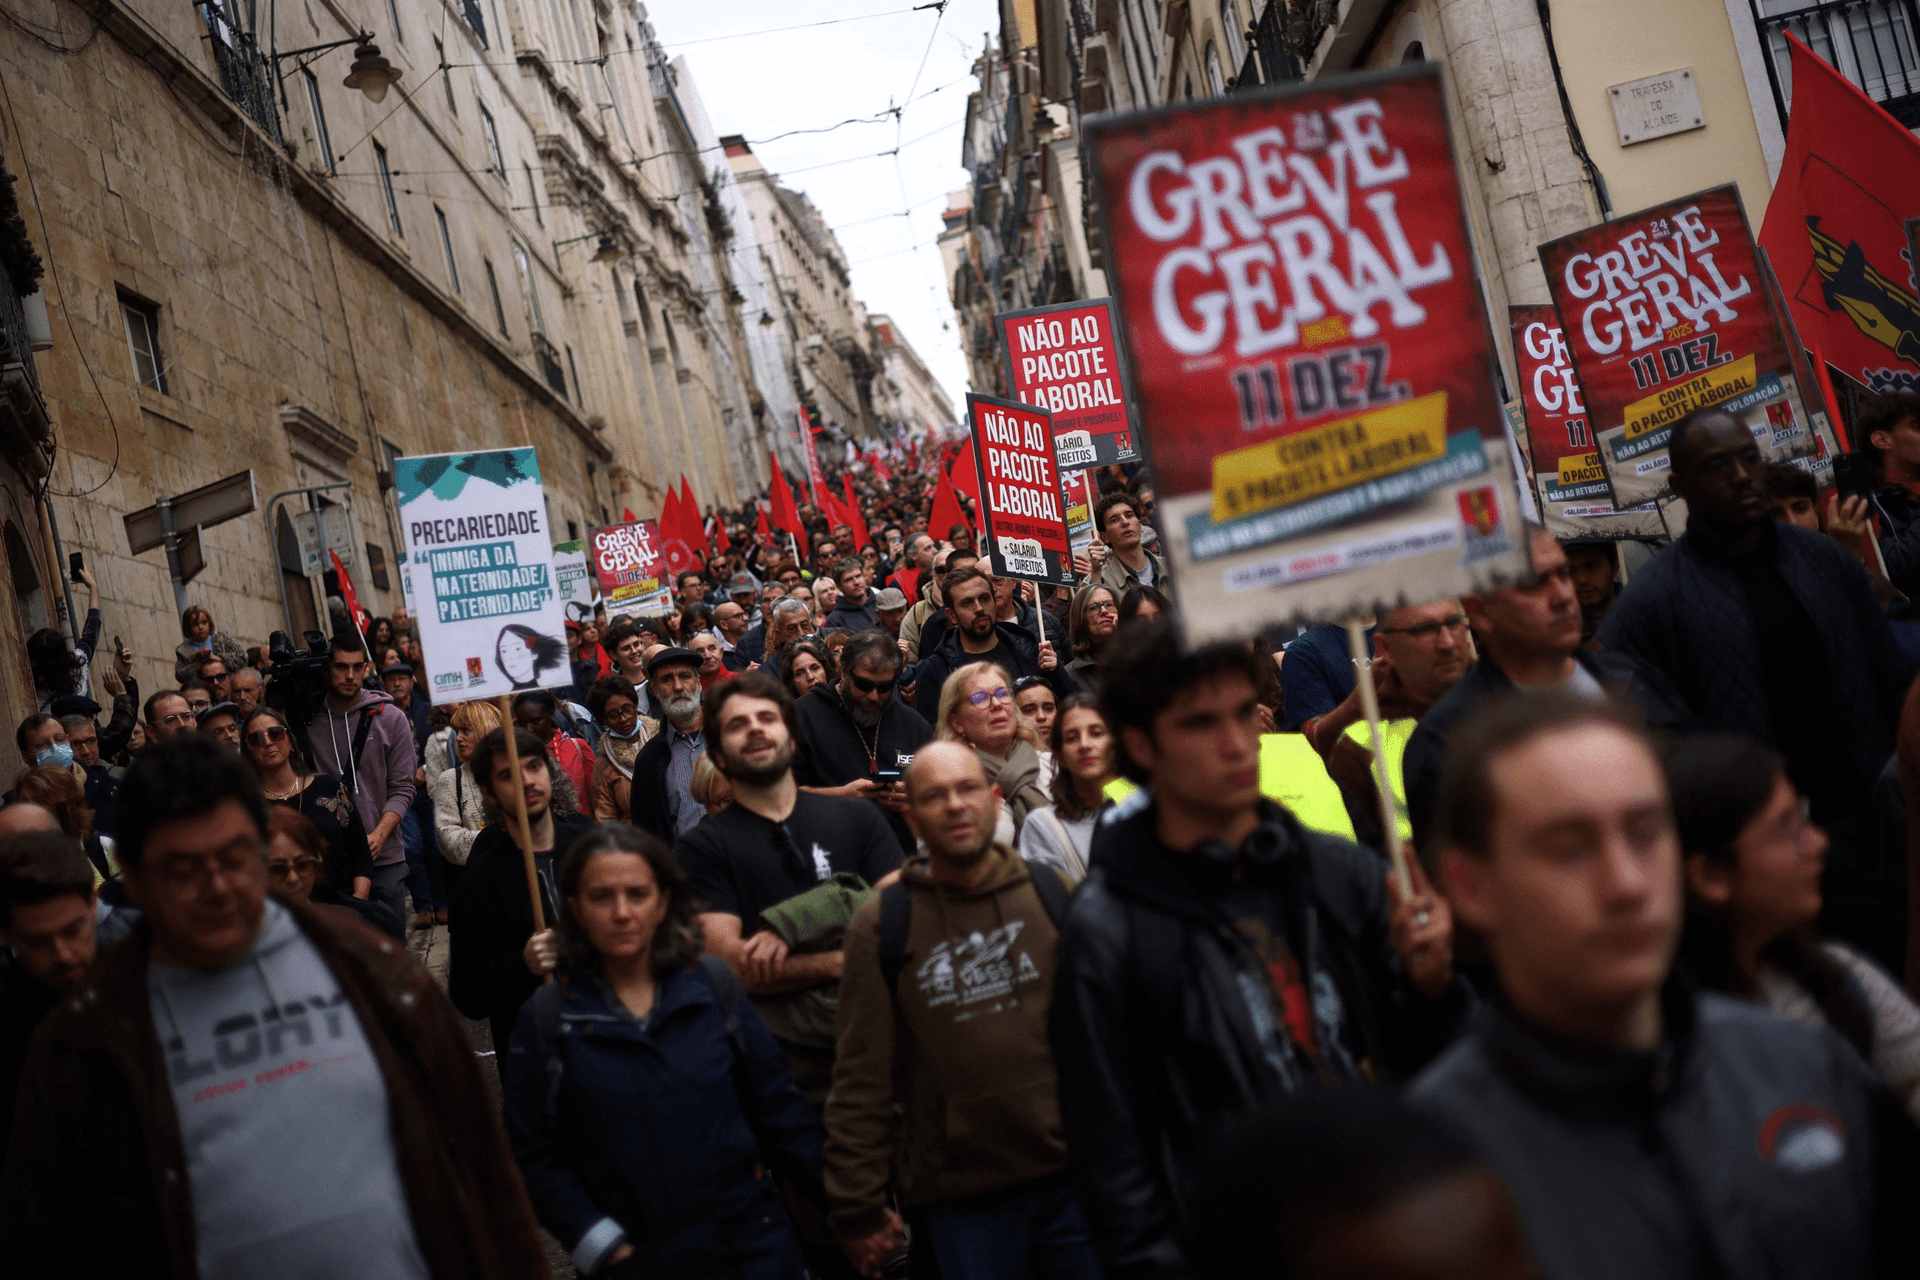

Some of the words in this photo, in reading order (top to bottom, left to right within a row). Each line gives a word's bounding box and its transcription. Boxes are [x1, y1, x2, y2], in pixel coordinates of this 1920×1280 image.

[1631, 80, 1674, 99] TRAVESSA
[1650, 100, 1663, 111] DO
[1643, 113, 1680, 130] ALCAIDE
[1129, 99, 1409, 252] GREVE
[1650, 218, 1669, 234] 24
[1565, 206, 1719, 300] GREVE
[1153, 192, 1453, 356] GERAL
[1582, 252, 1751, 355] GERAL
[1018, 318, 1065, 352] NÃO
[1071, 315, 1100, 345] AO
[1666, 322, 1693, 341] 2025
[1022, 346, 1108, 385] PACOTE
[1628, 353, 1661, 389] 11
[1660, 332, 1734, 380] DEZ.
[1231, 366, 1285, 430] 11
[1290, 344, 1411, 419] DEZ.
[1658, 376, 1711, 407] CONTRA
[984, 410, 1020, 447] NÃO
[1024, 420, 1044, 452] AO
[1630, 420, 1642, 434] O
[1642, 402, 1689, 431] PACOTE
[1057, 436, 1083, 450] LÁRIO
[1565, 419, 1587, 447] 11
[1774, 426, 1800, 440] CGTP
[1058, 449, 1092, 464] IREITOS
[1615, 443, 1636, 461] NÃO
[1637, 438, 1650, 451] AO
[988, 447, 1052, 487] PACOTE
[1563, 472, 1570, 482] O
[1810, 457, 1832, 471] CGTP
[987, 482, 1063, 523] LABORAL
[1550, 489, 1564, 500] NÃO
[1565, 488, 1575, 498] AO
[1576, 483, 1609, 496] RETROCES
[411, 510, 540, 546] PRECARIEDADE
[596, 523, 650, 552] GREVE
[494, 545, 515, 567] DA
[600, 540, 659, 572] GERAL
[1009, 542, 1037, 558] SALÁRIO
[627, 569, 652, 583] DEZ.
[1014, 558, 1045, 574] DIREITOS
[435, 564, 545, 597] MATERNIDADE/
